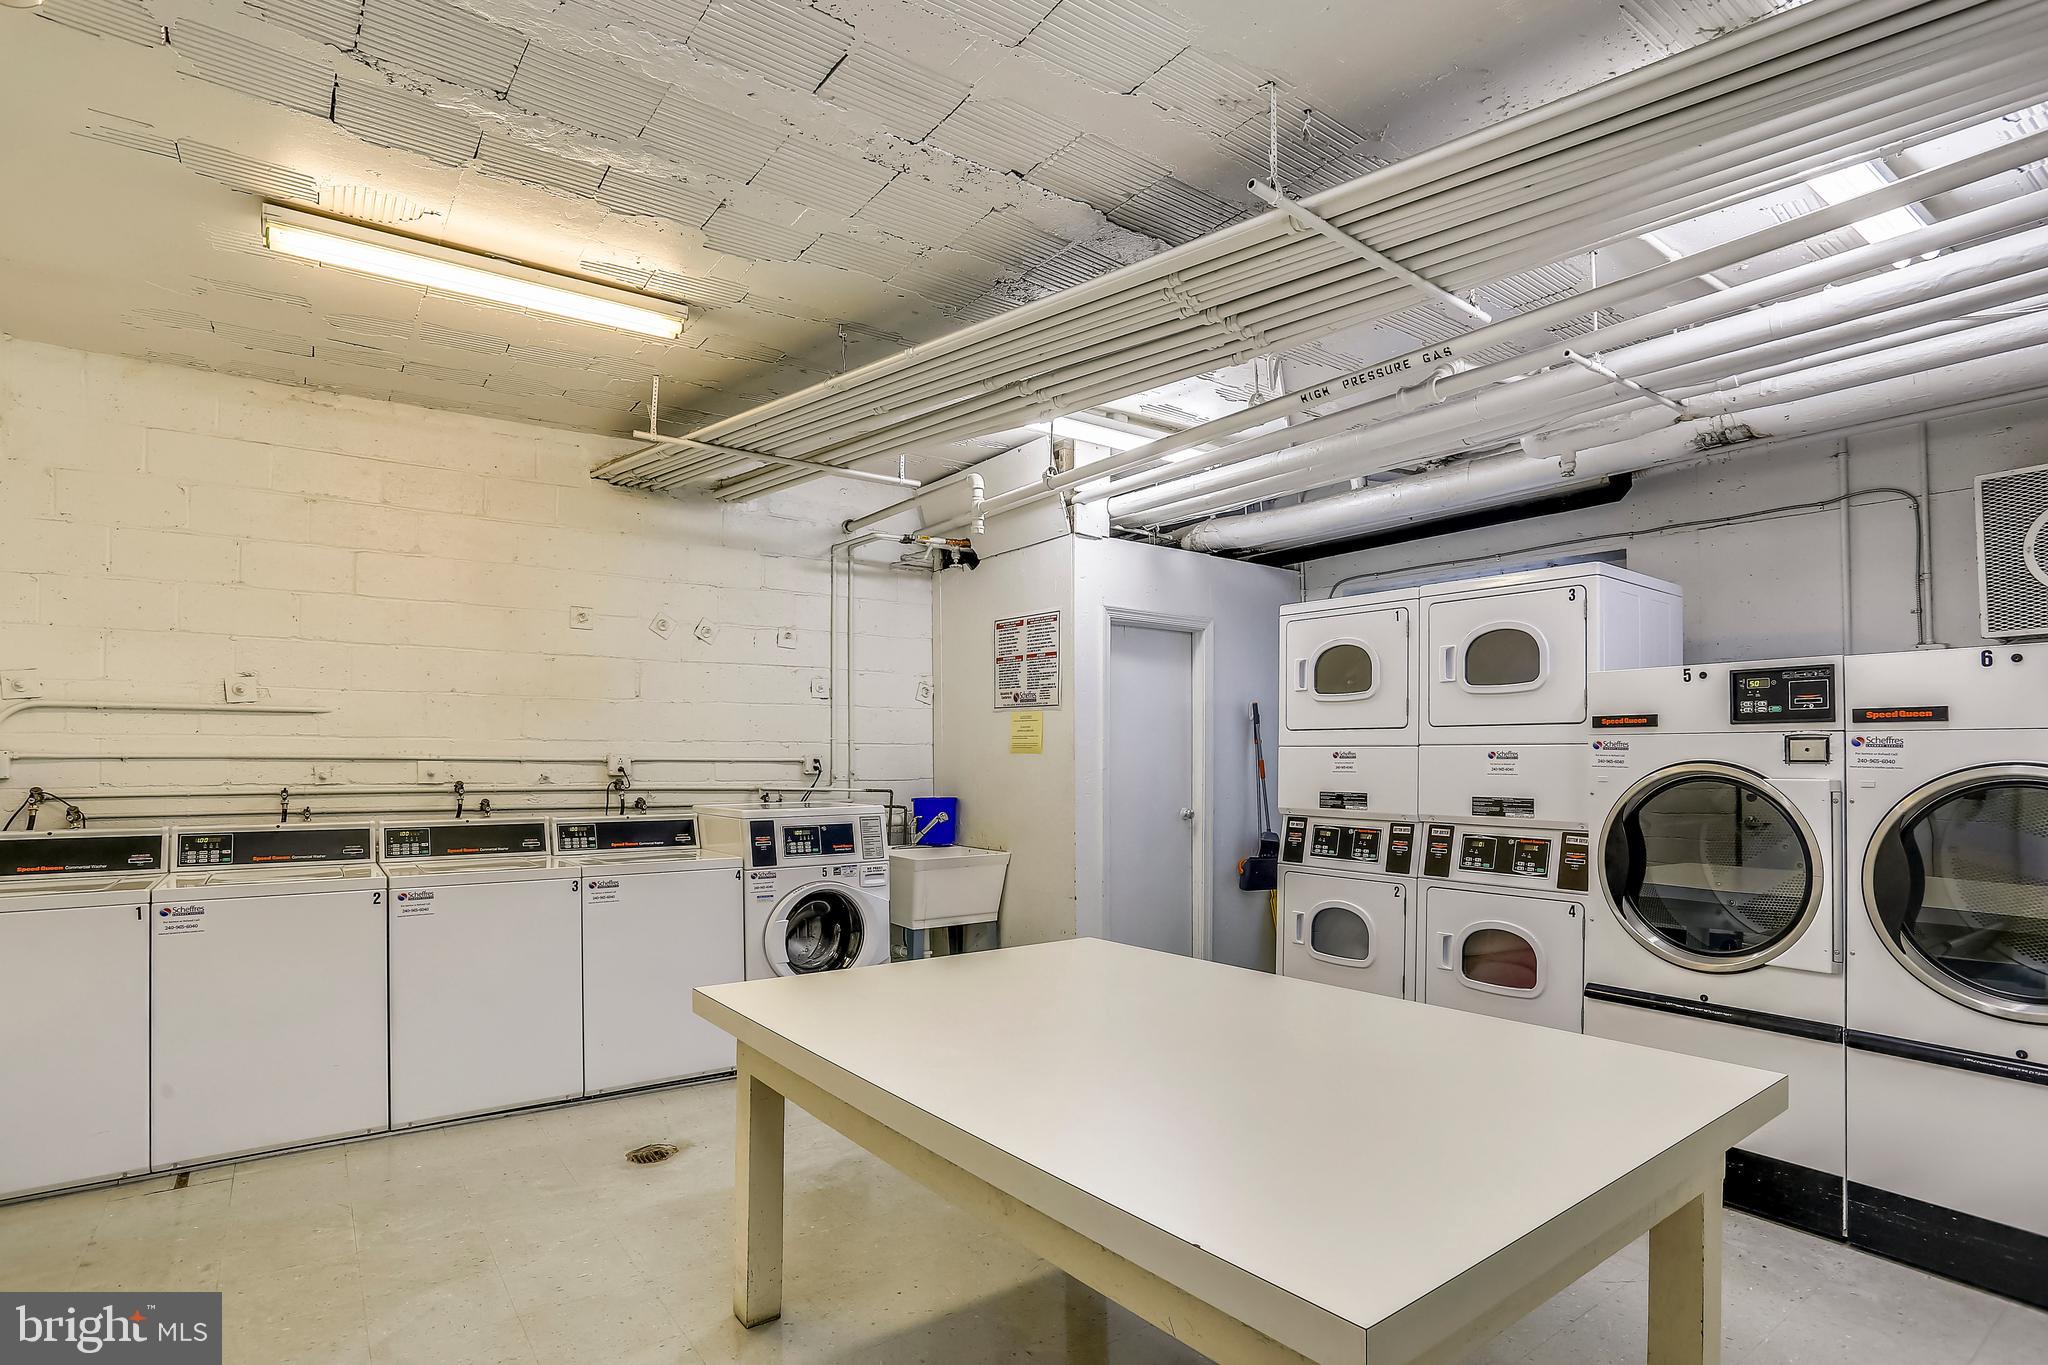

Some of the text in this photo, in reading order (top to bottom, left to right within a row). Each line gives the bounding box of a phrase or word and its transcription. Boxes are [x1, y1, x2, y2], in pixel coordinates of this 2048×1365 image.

[1300, 346, 1453, 404] HIGH PRESSURE GAS
[1568, 588, 1576, 602] 3
[1394, 610, 1400, 622] 1
[1981, 650, 1993, 668] 6
[1683, 668, 1691, 683] 5
[1866, 710, 1933, 719] Speed Queen
[1602, 740, 1630, 748] Scheffres
[1865, 735, 1904, 744] Scheffres
[735, 869, 742, 881] 4
[822, 867, 828, 878] 5
[571, 880, 579, 892] 3
[1394, 886, 1400, 898] 2
[373, 892, 382, 905] 2
[135, 906, 142, 921] 1
[172, 905, 205, 914] Scheffres
[1568, 904, 1576, 918] 4
[164, 923, 199, 931] 240-965-6040
